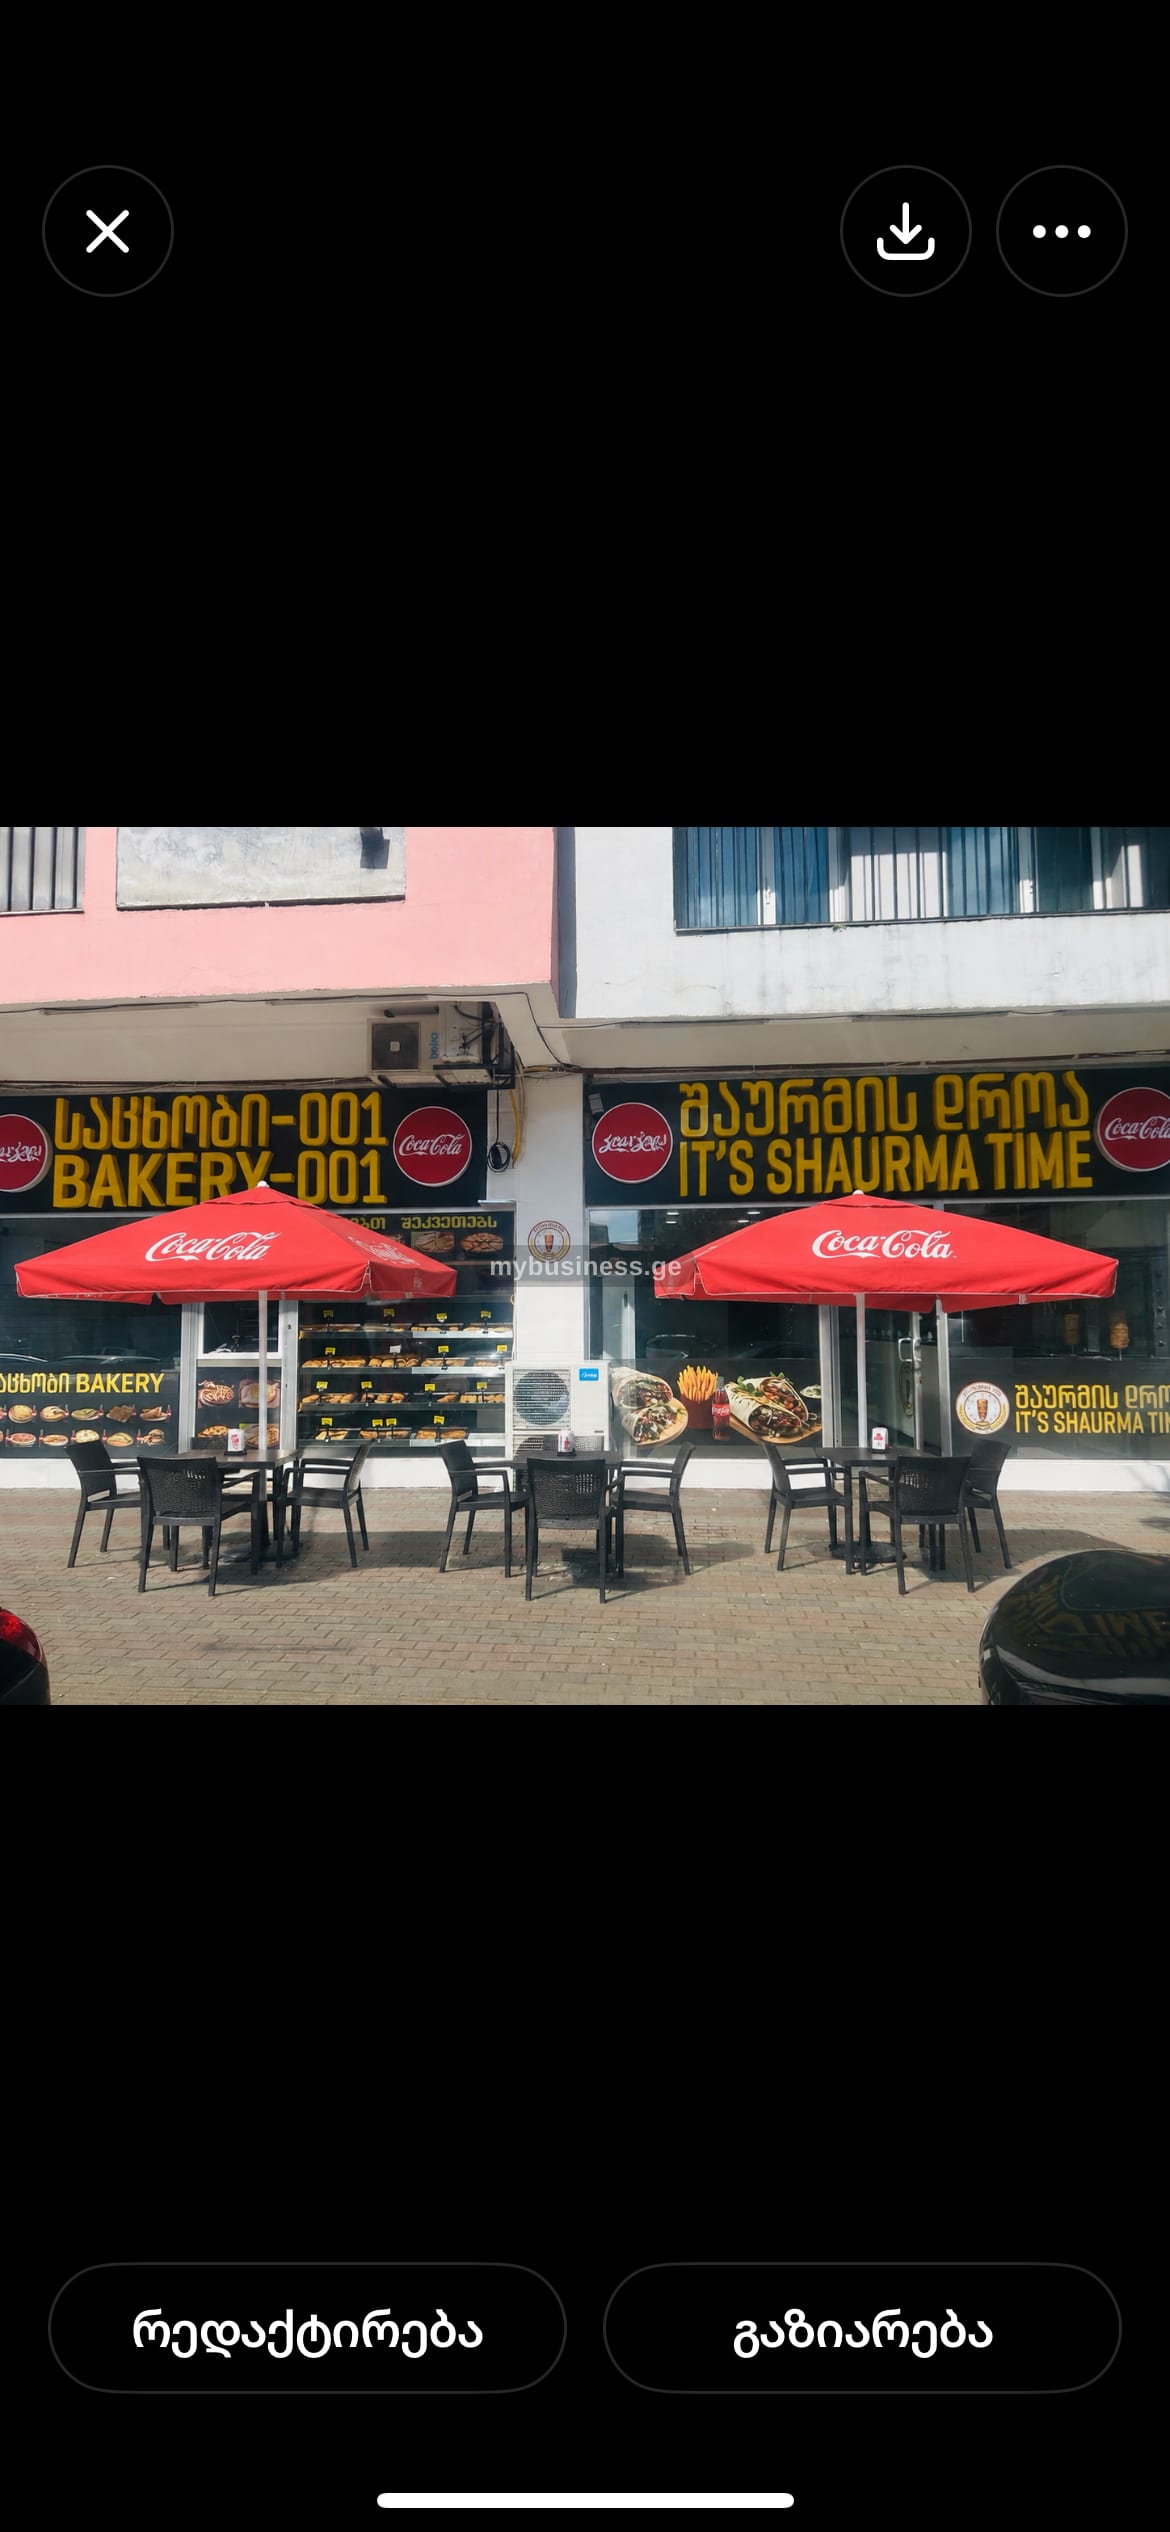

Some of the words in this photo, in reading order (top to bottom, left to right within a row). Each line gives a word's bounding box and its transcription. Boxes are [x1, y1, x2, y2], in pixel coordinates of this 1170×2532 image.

[680, 1076, 918, 1139] შაურმის
[934, 1071, 1090, 1131] დროა
[54, 1091, 389, 1151] საცხობი-001
[399, 1134, 465, 1156] Coca-Cola
[53, 1149, 388, 1208] BAKERY-001
[680, 1139, 754, 1197] IT'S
[767, 1133, 980, 1196] SHAURMA
[984, 1130, 1093, 1191] TIME
[401, 1215, 497, 1229] შეკვეთებს
[145, 1231, 282, 1262] Coca-Cola
[811, 1229, 954, 1259] Coca-Cola
[0, 1373, 70, 1393] აცხობი
[76, 1373, 165, 1393] BAKERY
[1015, 1384, 1119, 1409] შაურმის
[1124, 1384, 1170, 1409] დრო
[1015, 1411, 1049, 1434] IT'S
[1053, 1411, 1145, 1434] SHAURMA
[1147, 1411, 1170, 1434] TI
